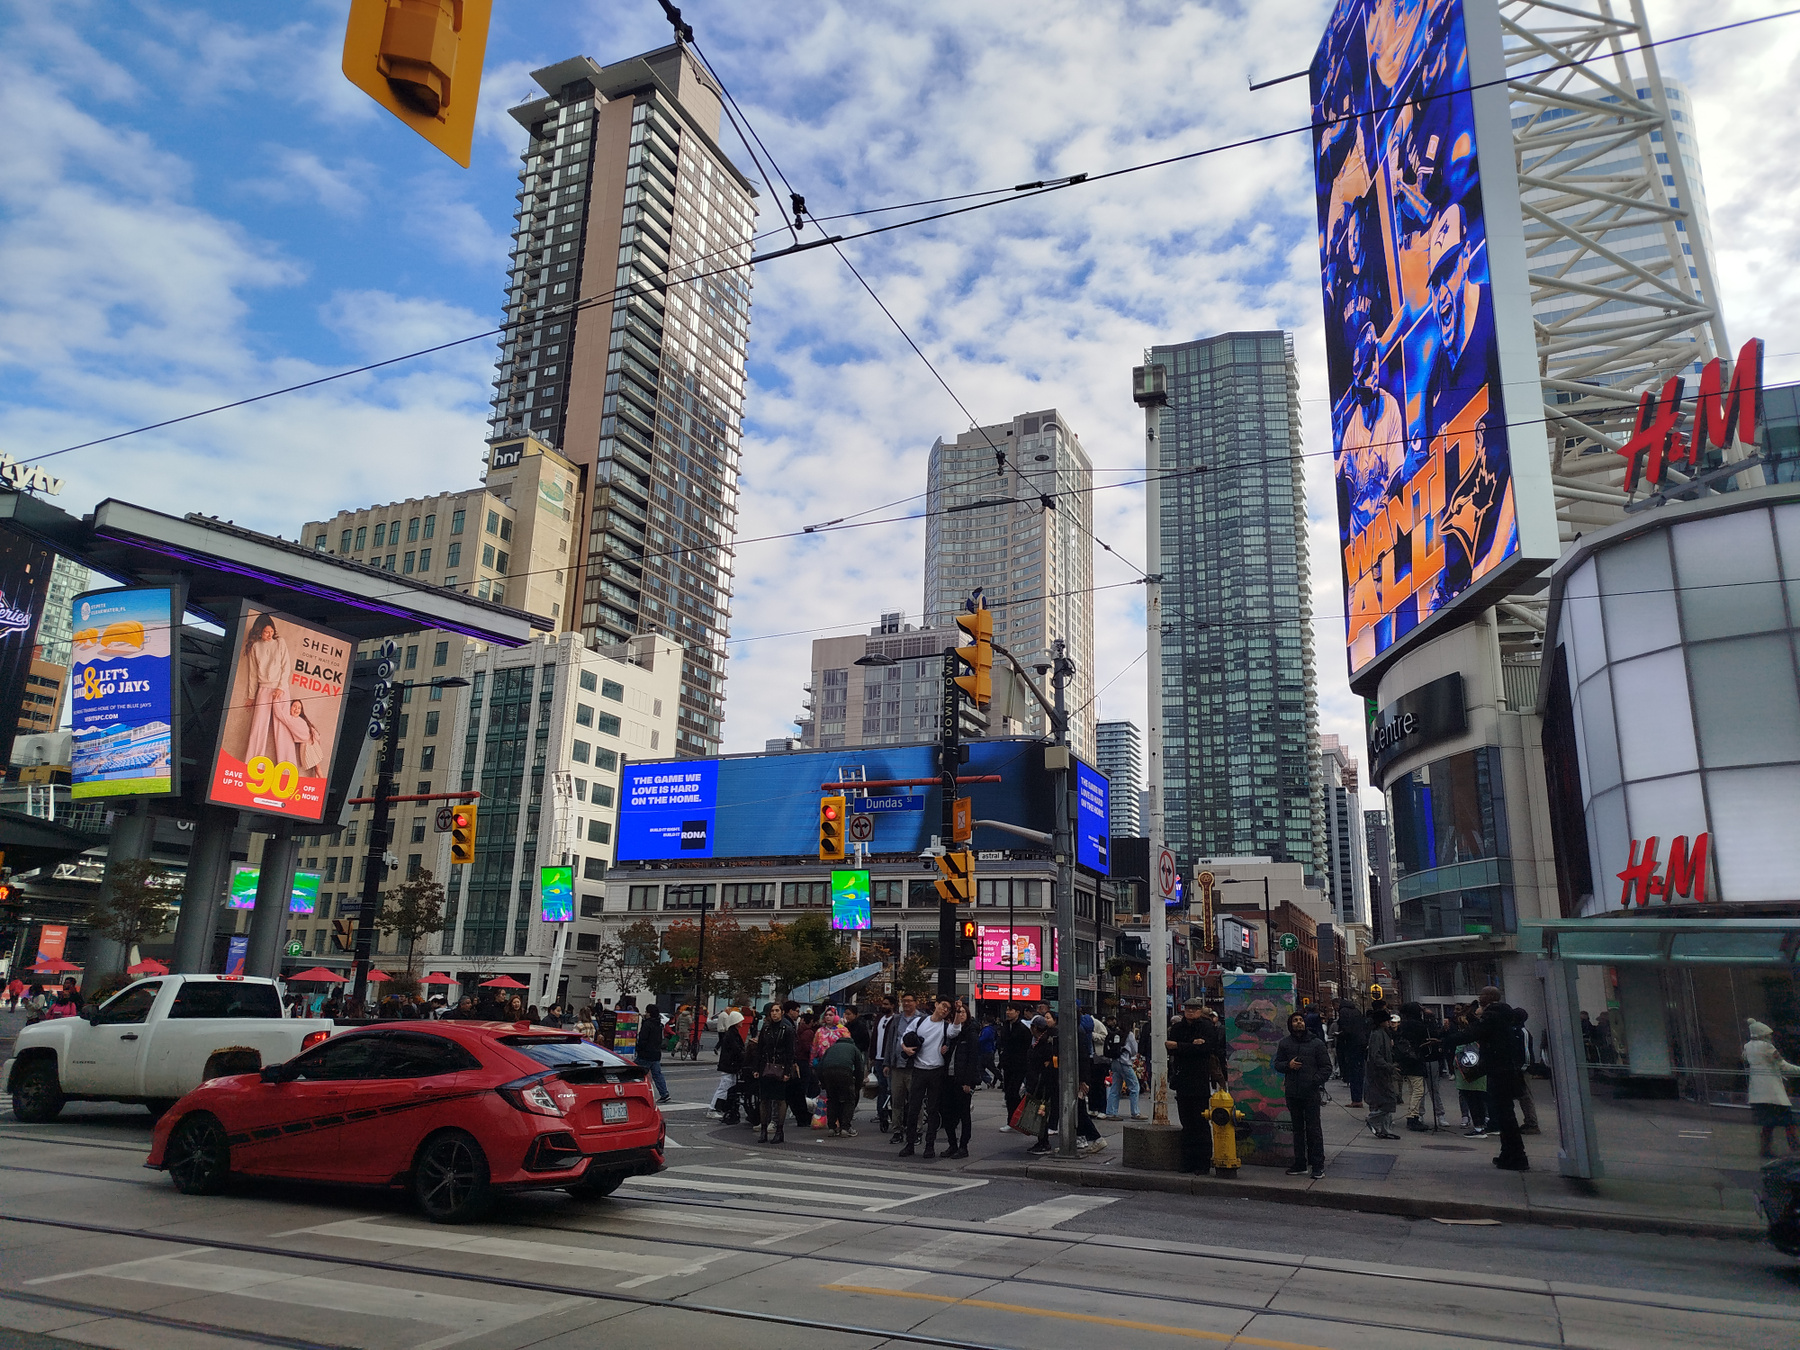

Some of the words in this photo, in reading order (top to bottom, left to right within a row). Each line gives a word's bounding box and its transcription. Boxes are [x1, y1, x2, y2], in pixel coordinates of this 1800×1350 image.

[1617, 337, 1762, 492] H&M
[494, 448, 521, 467] hnr
[1345, 456, 1437, 587] WANT
[1429, 382, 1489, 519] IT
[1347, 519, 1446, 647] ALL
[302, 637, 343, 659] SHEIN
[99, 668, 129, 681] LET'S
[295, 659, 343, 684] BLACK
[84, 667, 103, 700] &
[100, 683, 115, 695] GO
[118, 680, 150, 693] JAYS
[291, 673, 341, 697] FRIDAY
[945, 655, 954, 737] DOWNTOWN
[1374, 712, 1414, 753] Centre
[224, 769, 243, 779] SAVE
[633, 776, 653, 785] THE
[654, 774, 684, 784] GAME
[685, 773, 702, 782] WE
[233, 779, 243, 787] TO
[632, 786, 658, 795] LOVE
[659, 785, 669, 794] IS
[670, 784, 699, 793] HARD
[301, 793, 319, 801] NOW!
[631, 797, 646, 805] ON
[648, 796, 668, 805] THE
[669, 794, 702, 804] HOME.
[866, 799, 903, 809] Dundas
[981, 851, 1000, 860] astral
[1616, 832, 1710, 906] H&M
[292, 944, 300, 953] P
